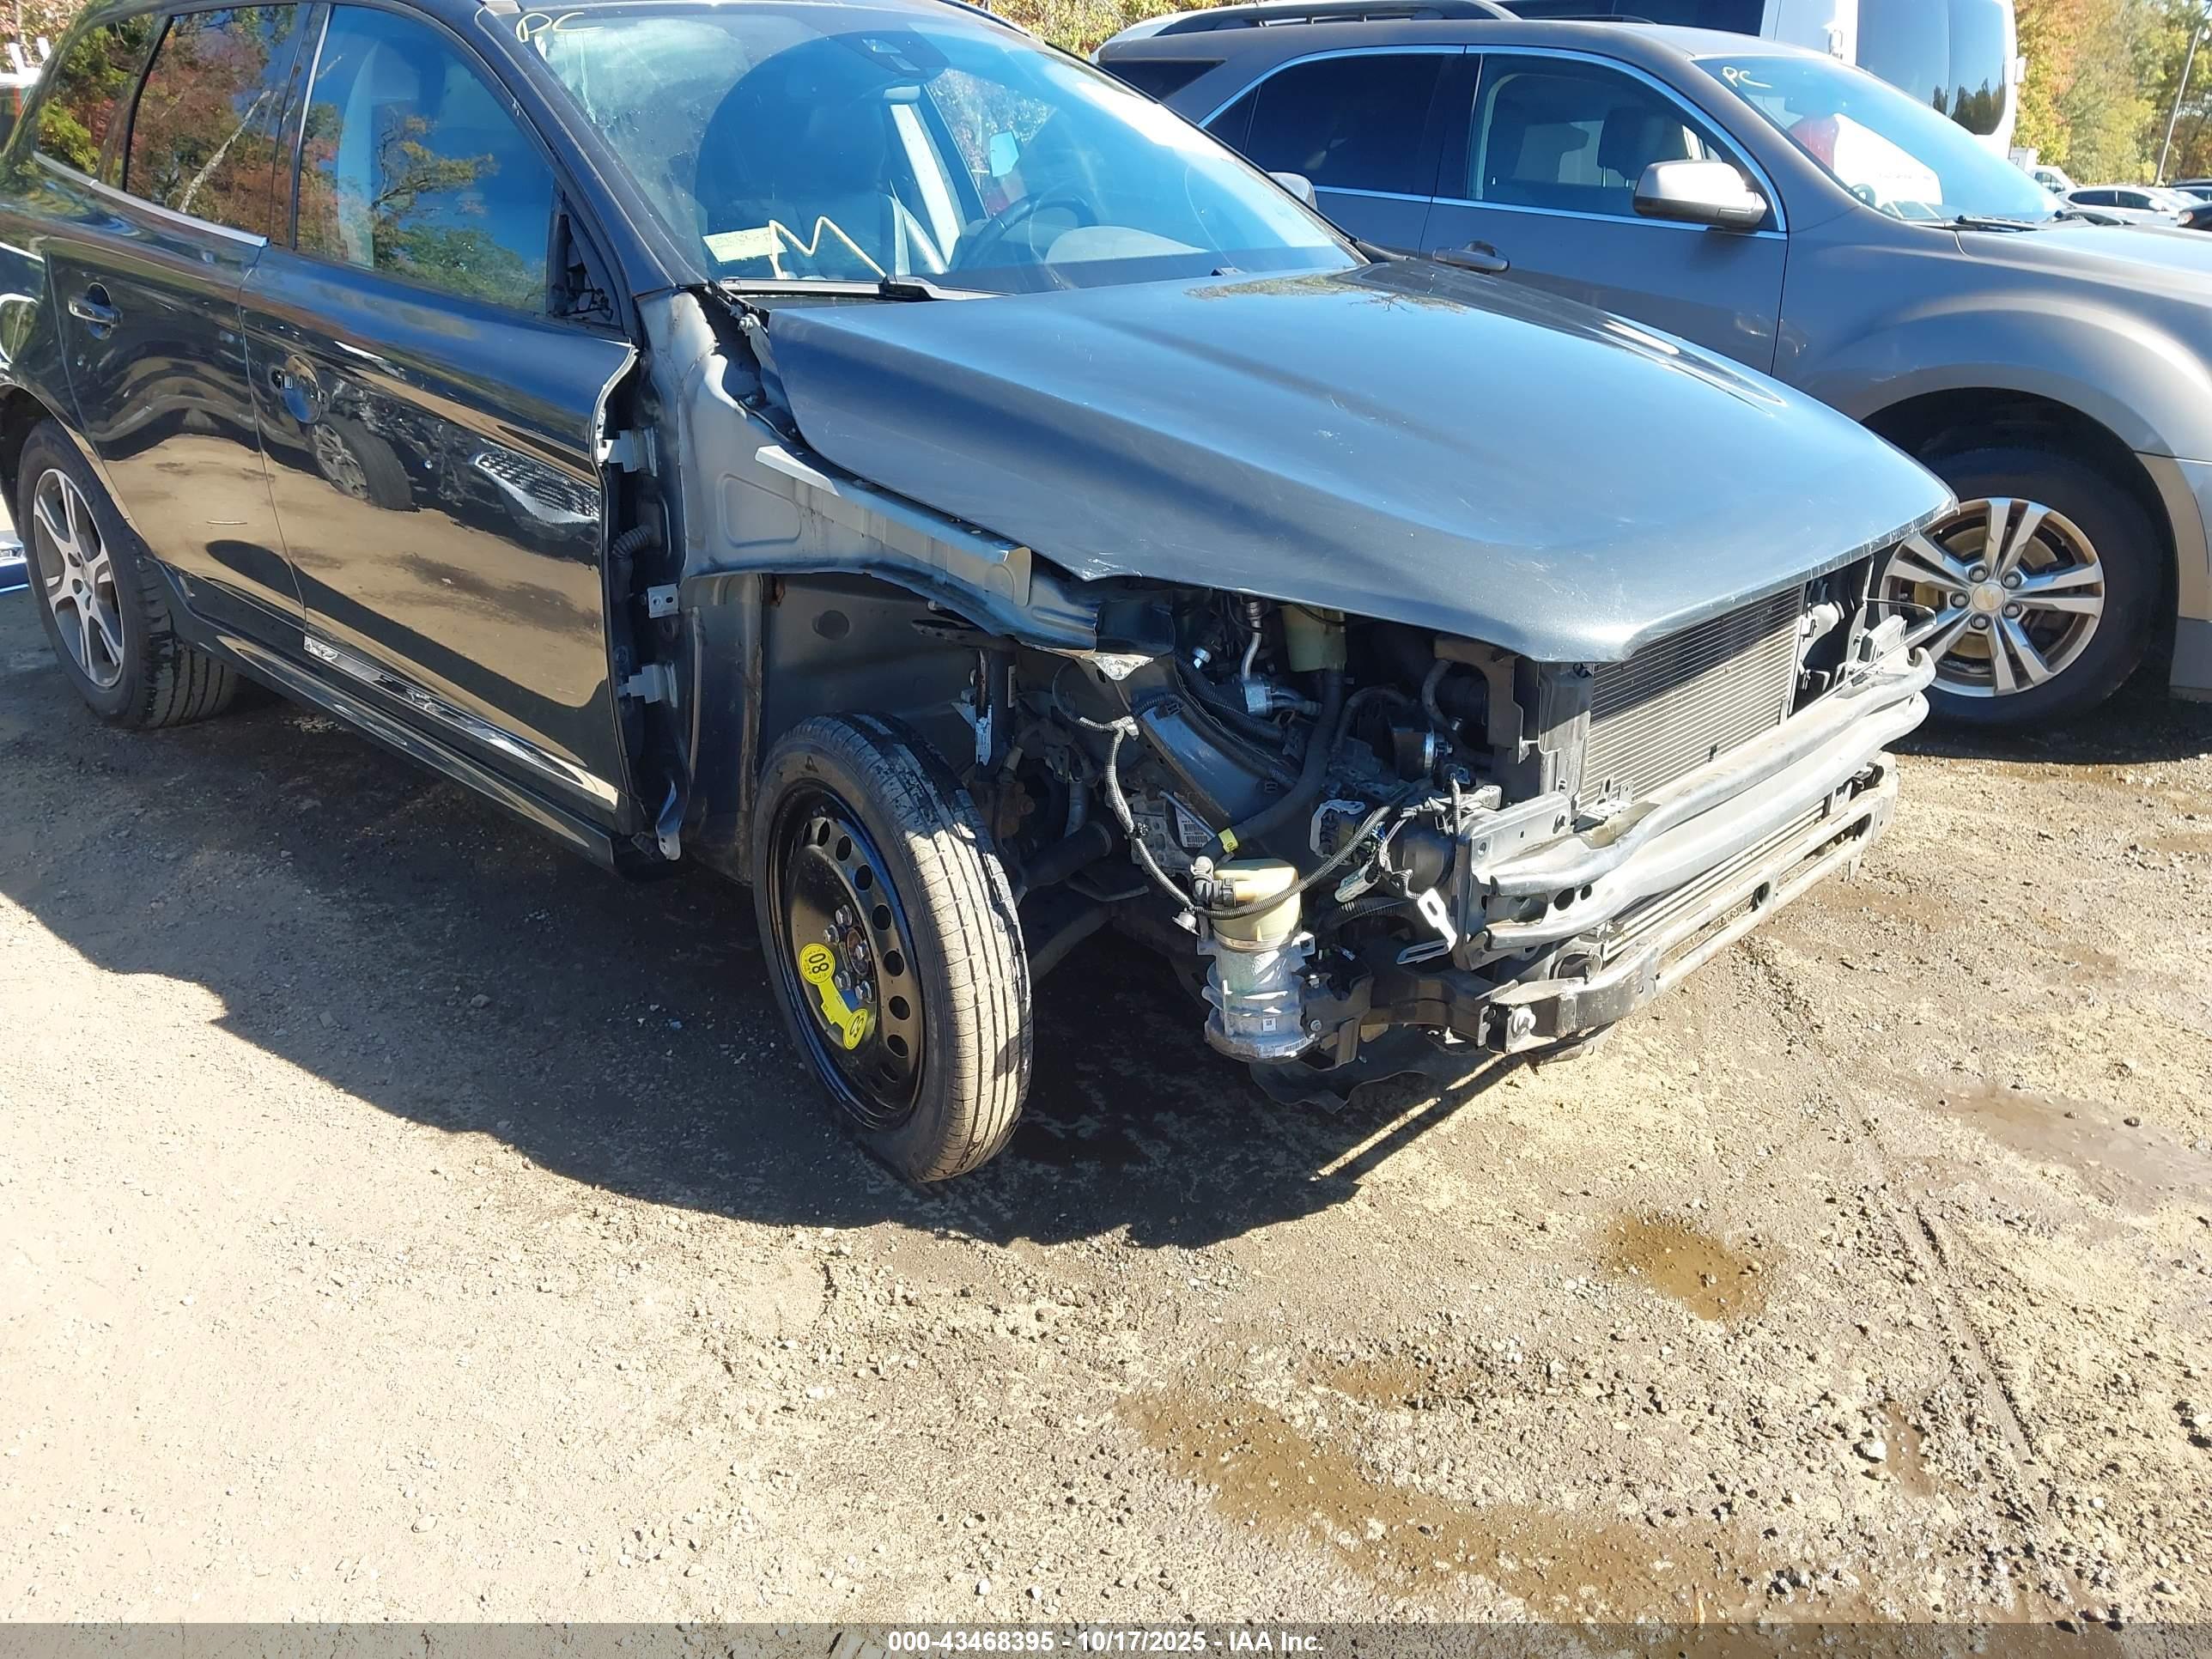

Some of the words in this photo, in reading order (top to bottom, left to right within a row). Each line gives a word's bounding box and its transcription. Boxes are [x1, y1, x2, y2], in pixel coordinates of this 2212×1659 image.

[515, 11, 605, 43] PC
[1722, 65, 1773, 88] PC
[809, 952, 830, 974] 80
